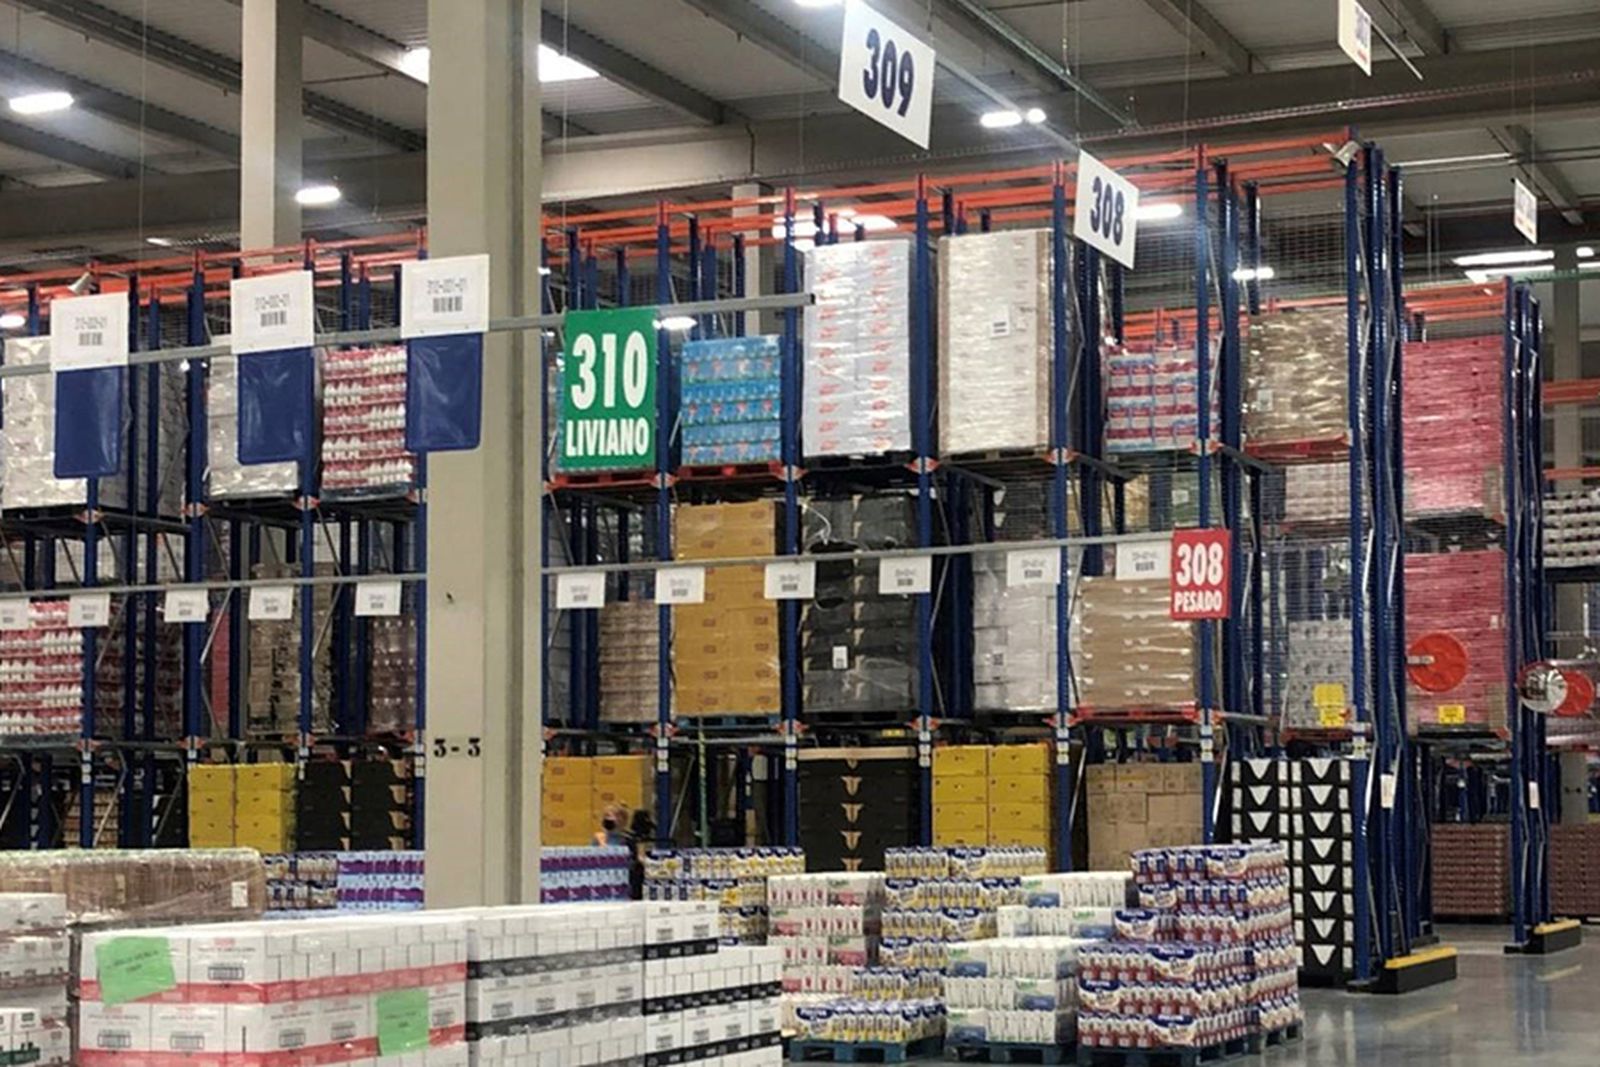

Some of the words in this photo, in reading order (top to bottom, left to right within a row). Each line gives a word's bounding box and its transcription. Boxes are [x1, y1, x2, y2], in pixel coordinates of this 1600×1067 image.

[864, 28, 914, 117] 309
[1090, 176, 1125, 246] 308
[571, 331, 648, 410] 310
[566, 417, 650, 457] LIVIANO
[1176, 542, 1223, 586] 308
[1174, 590, 1222, 613] PESADO
